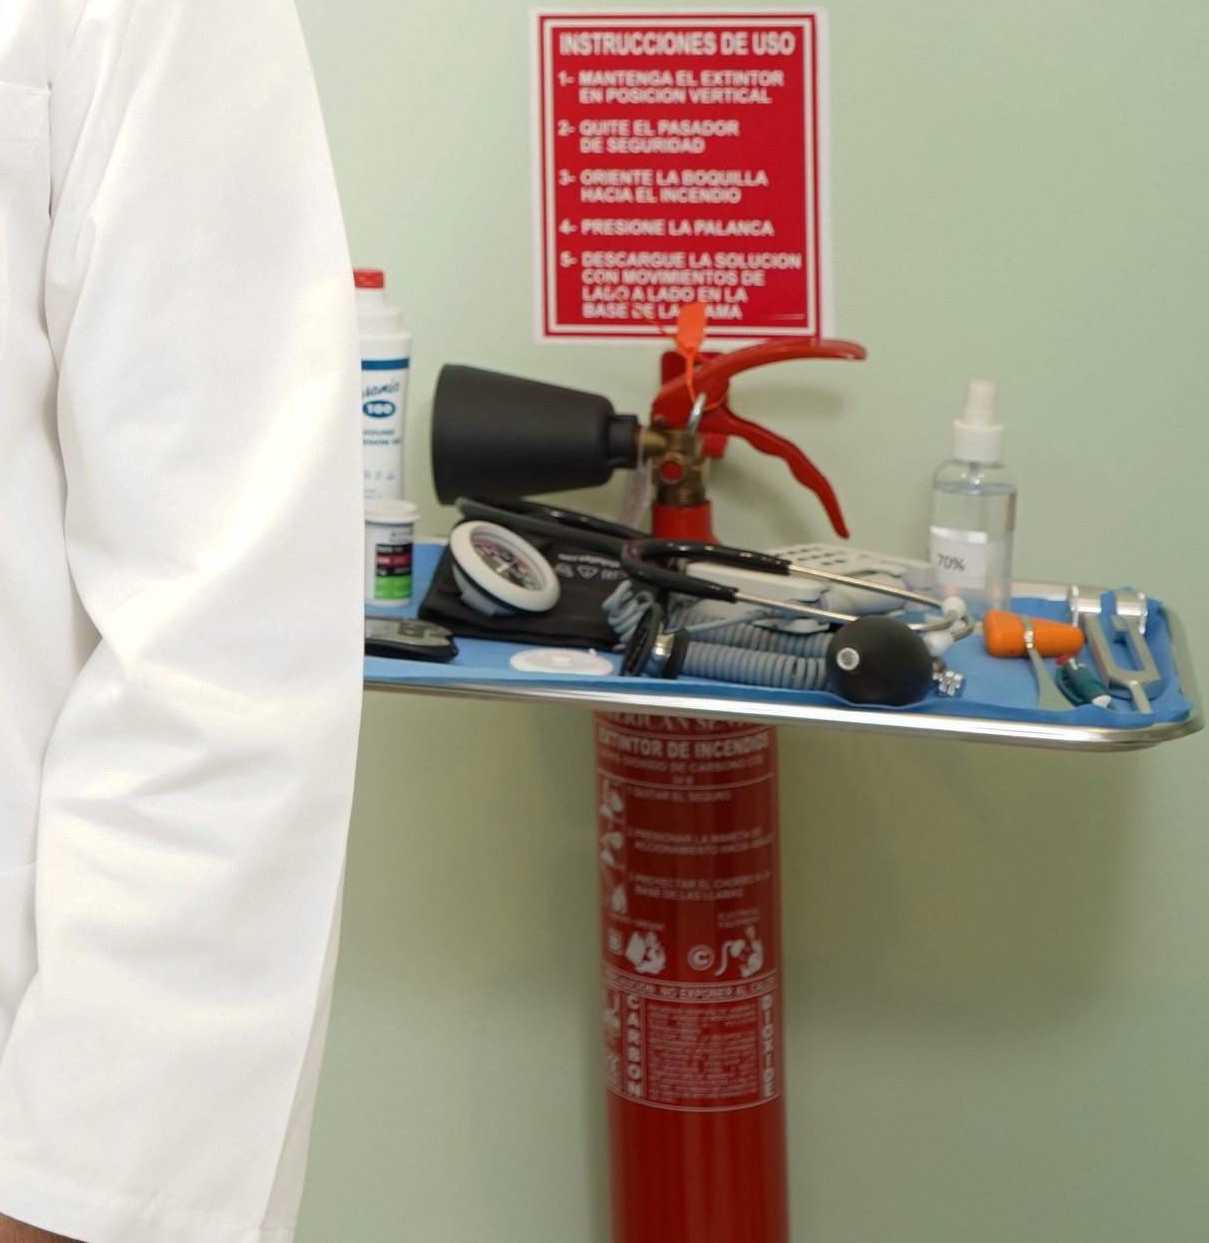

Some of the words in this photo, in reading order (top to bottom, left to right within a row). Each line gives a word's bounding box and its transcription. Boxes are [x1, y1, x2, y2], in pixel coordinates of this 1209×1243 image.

[560, 32, 717, 55] INSTRUCCIONES
[721, 32, 747, 55] DE
[752, 32, 795, 55] USO
[579, 70, 673, 86] MANTENGA
[676, 70, 697, 86] EL
[701, 70, 783, 86] EXTINTOR
[579, 87, 603, 103] EN
[606, 87, 686, 103] POSICION
[689, 88, 770, 103] VERTICAL
[580, 120, 629, 136] QUITE
[633, 120, 654, 136] EL
[658, 120, 739, 136] PASADOR
[580, 137, 602, 153] DE
[607, 137, 705, 153] SEGURIDAD
[580, 170, 652, 185] ORIENTE
[656, 171, 679, 186] LA
[682, 170, 767, 186] BOQUILLA
[581, 187, 633, 203] HACIA
[636, 187, 656, 203] EL
[660, 187, 741, 203] INCENDIO
[581, 219, 664, 235] PRESIONE
[669, 221, 692, 235] LA
[694, 220, 773, 236] PALANCA
[582, 252, 684, 268] DESCARGUE
[689, 253, 712, 268] LA
[715, 253, 801, 269] SOLUCION
[582, 269, 619, 287] CON
[622, 269, 737, 287] MOVIMIENTOS
[741, 270, 764, 286] DE
[583, 286, 629, 303] LADO
[647, 286, 694, 302] LADO
[698, 287, 721, 302] EN
[725, 285, 747, 302] LA
[583, 302, 627, 318] BASE
[632, 301, 654, 318] DE
[659, 301, 679, 319] LA
[937, 552, 965, 573] 70%
[666, 741, 691, 758] DE
